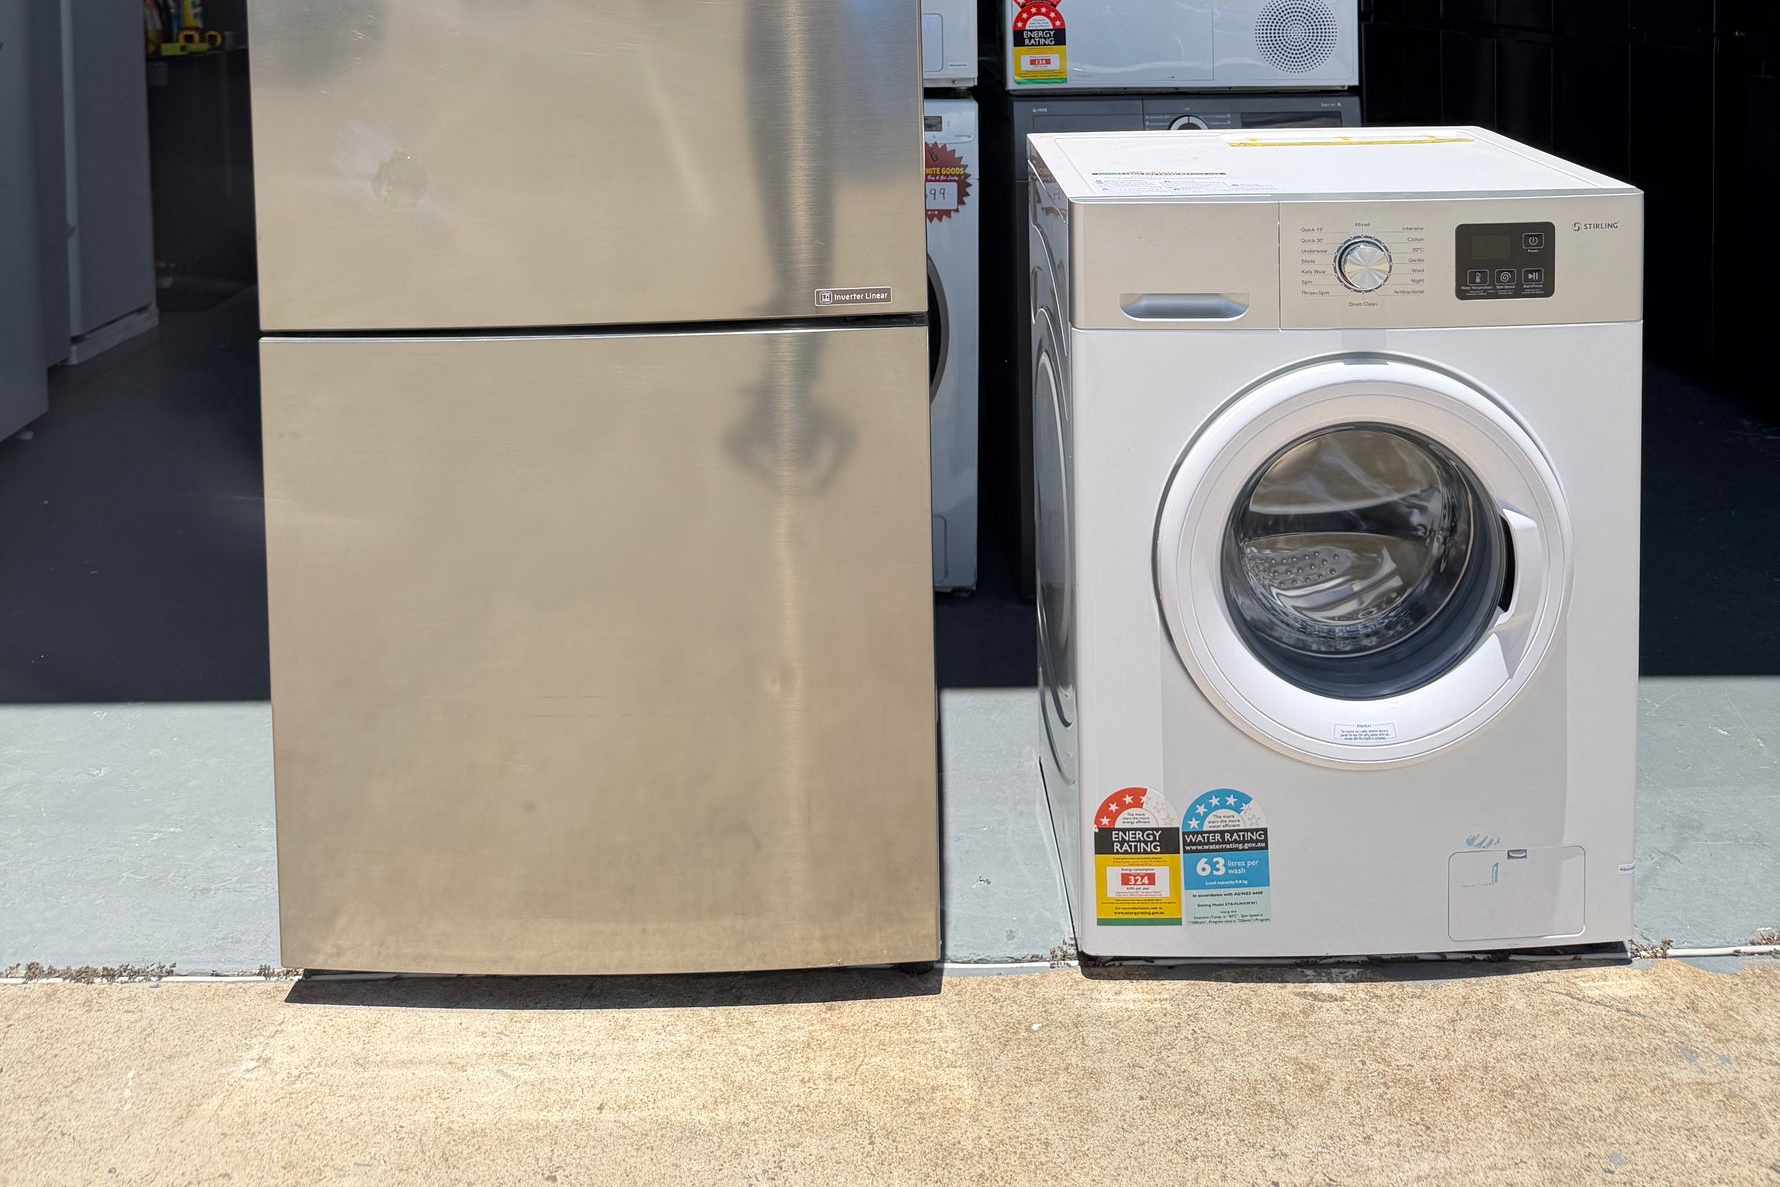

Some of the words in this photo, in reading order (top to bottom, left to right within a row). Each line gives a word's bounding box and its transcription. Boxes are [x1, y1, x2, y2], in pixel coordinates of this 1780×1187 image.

[928, 188, 946, 200] 99
[1583, 222, 1619, 230] STIRLING
[1112, 831, 1162, 841] ENERGY
[1184, 833, 1222, 842] WATER
[1225, 831, 1264, 840] RATING
[1114, 842, 1160, 852] RATING
[1185, 842, 1266, 850] www.waterrating.gov.au
[1196, 857, 1226, 876] 63
[1128, 876, 1149, 885] 324
